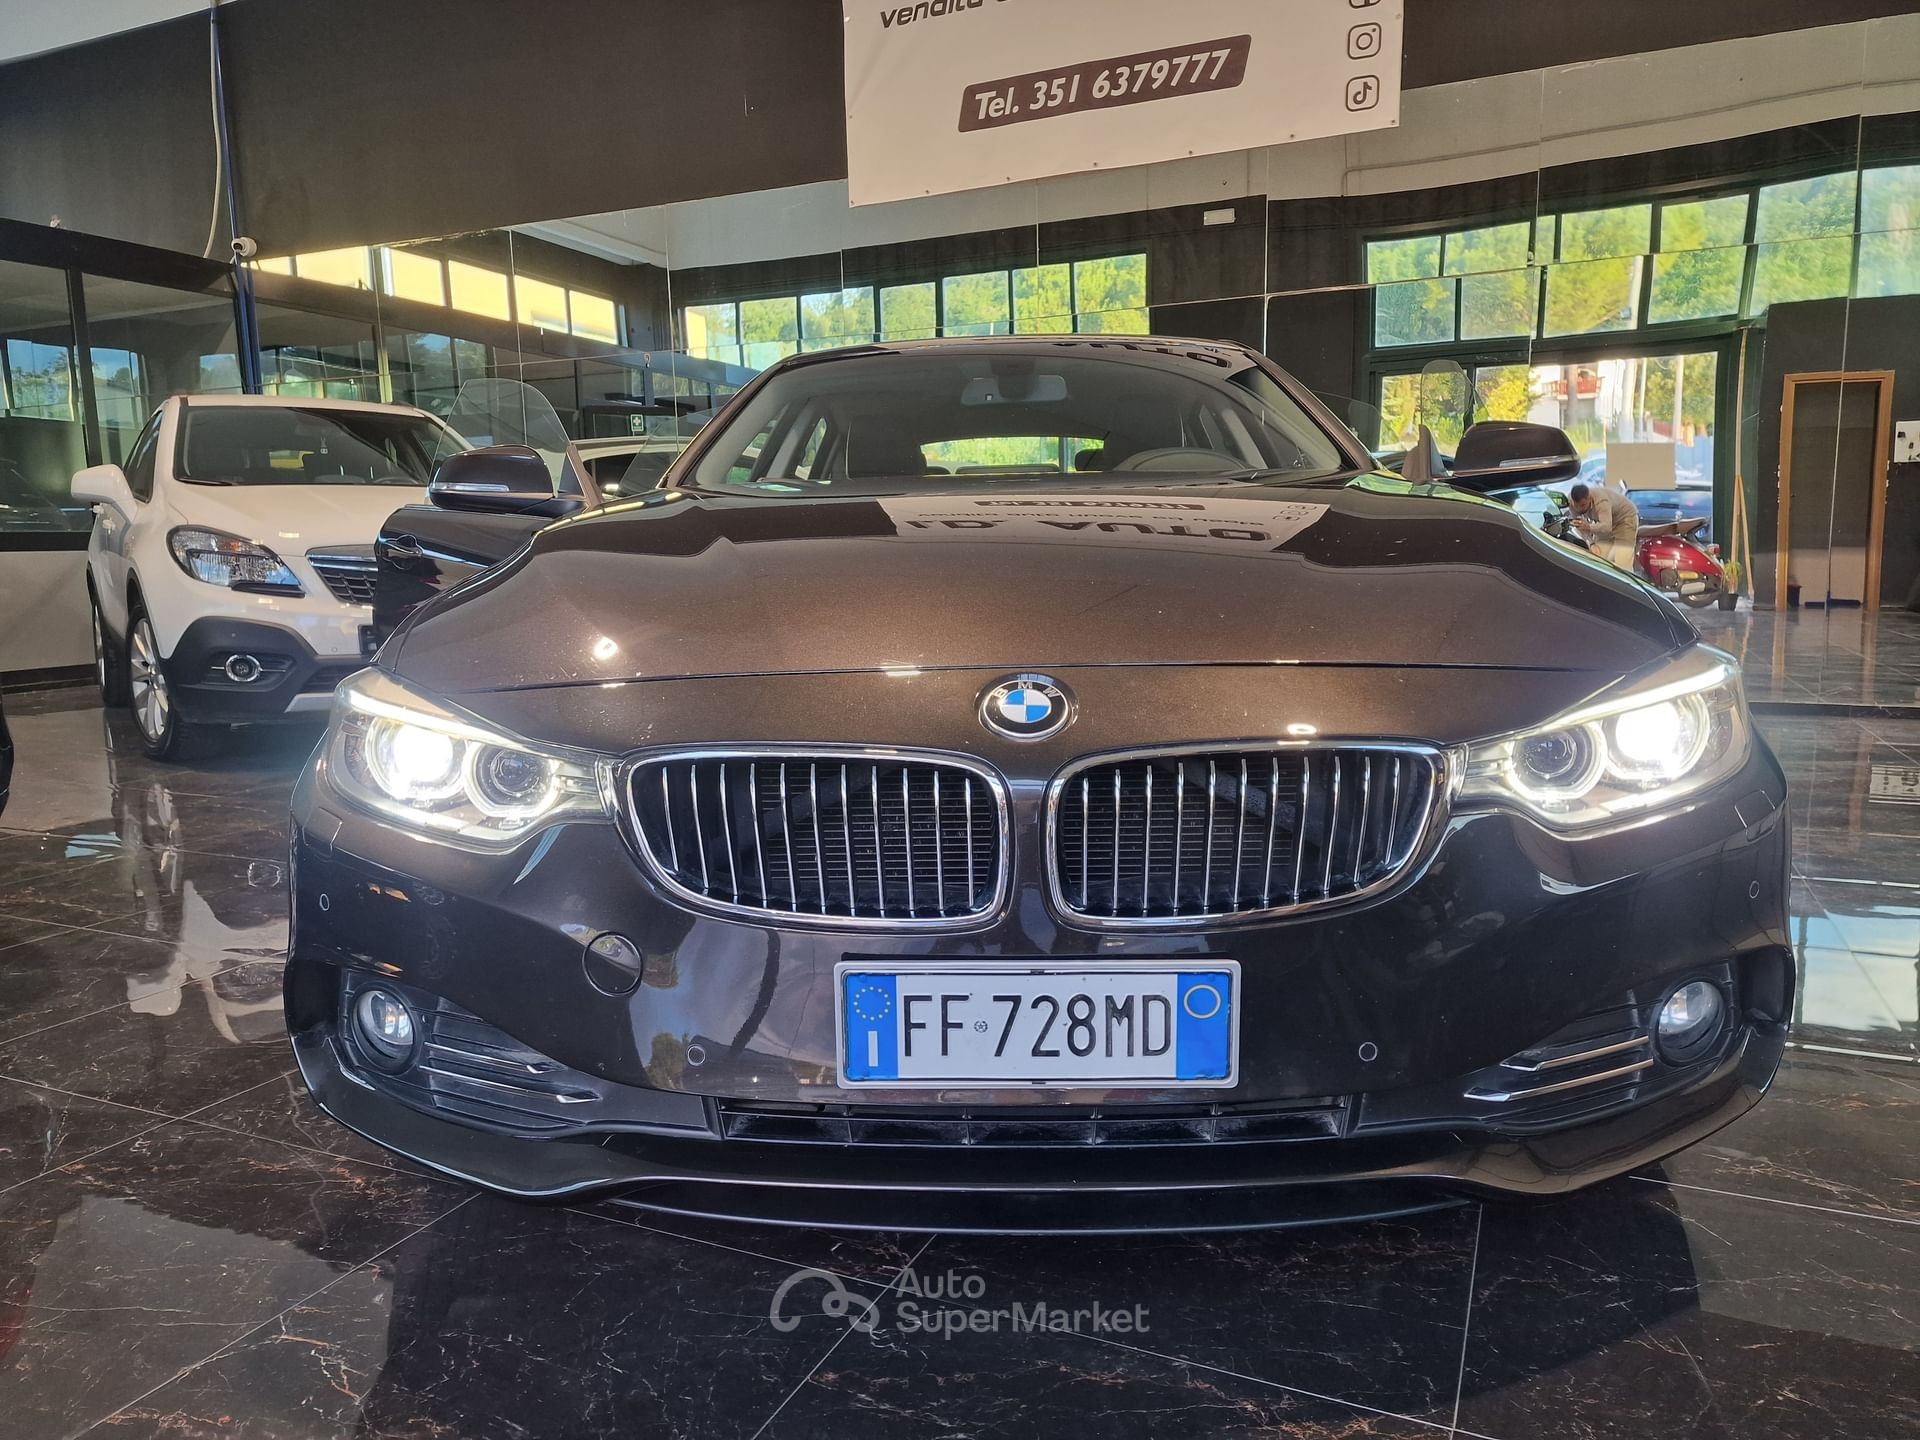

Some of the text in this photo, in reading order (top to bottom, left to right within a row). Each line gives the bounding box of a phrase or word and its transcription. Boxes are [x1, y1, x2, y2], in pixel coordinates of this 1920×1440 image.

[975, 48, 1231, 120] Tel. 351 6379777
[993, 681, 1061, 699] BMW
[904, 994, 970, 1057] FF
[992, 994, 1171, 1057] 728MD
